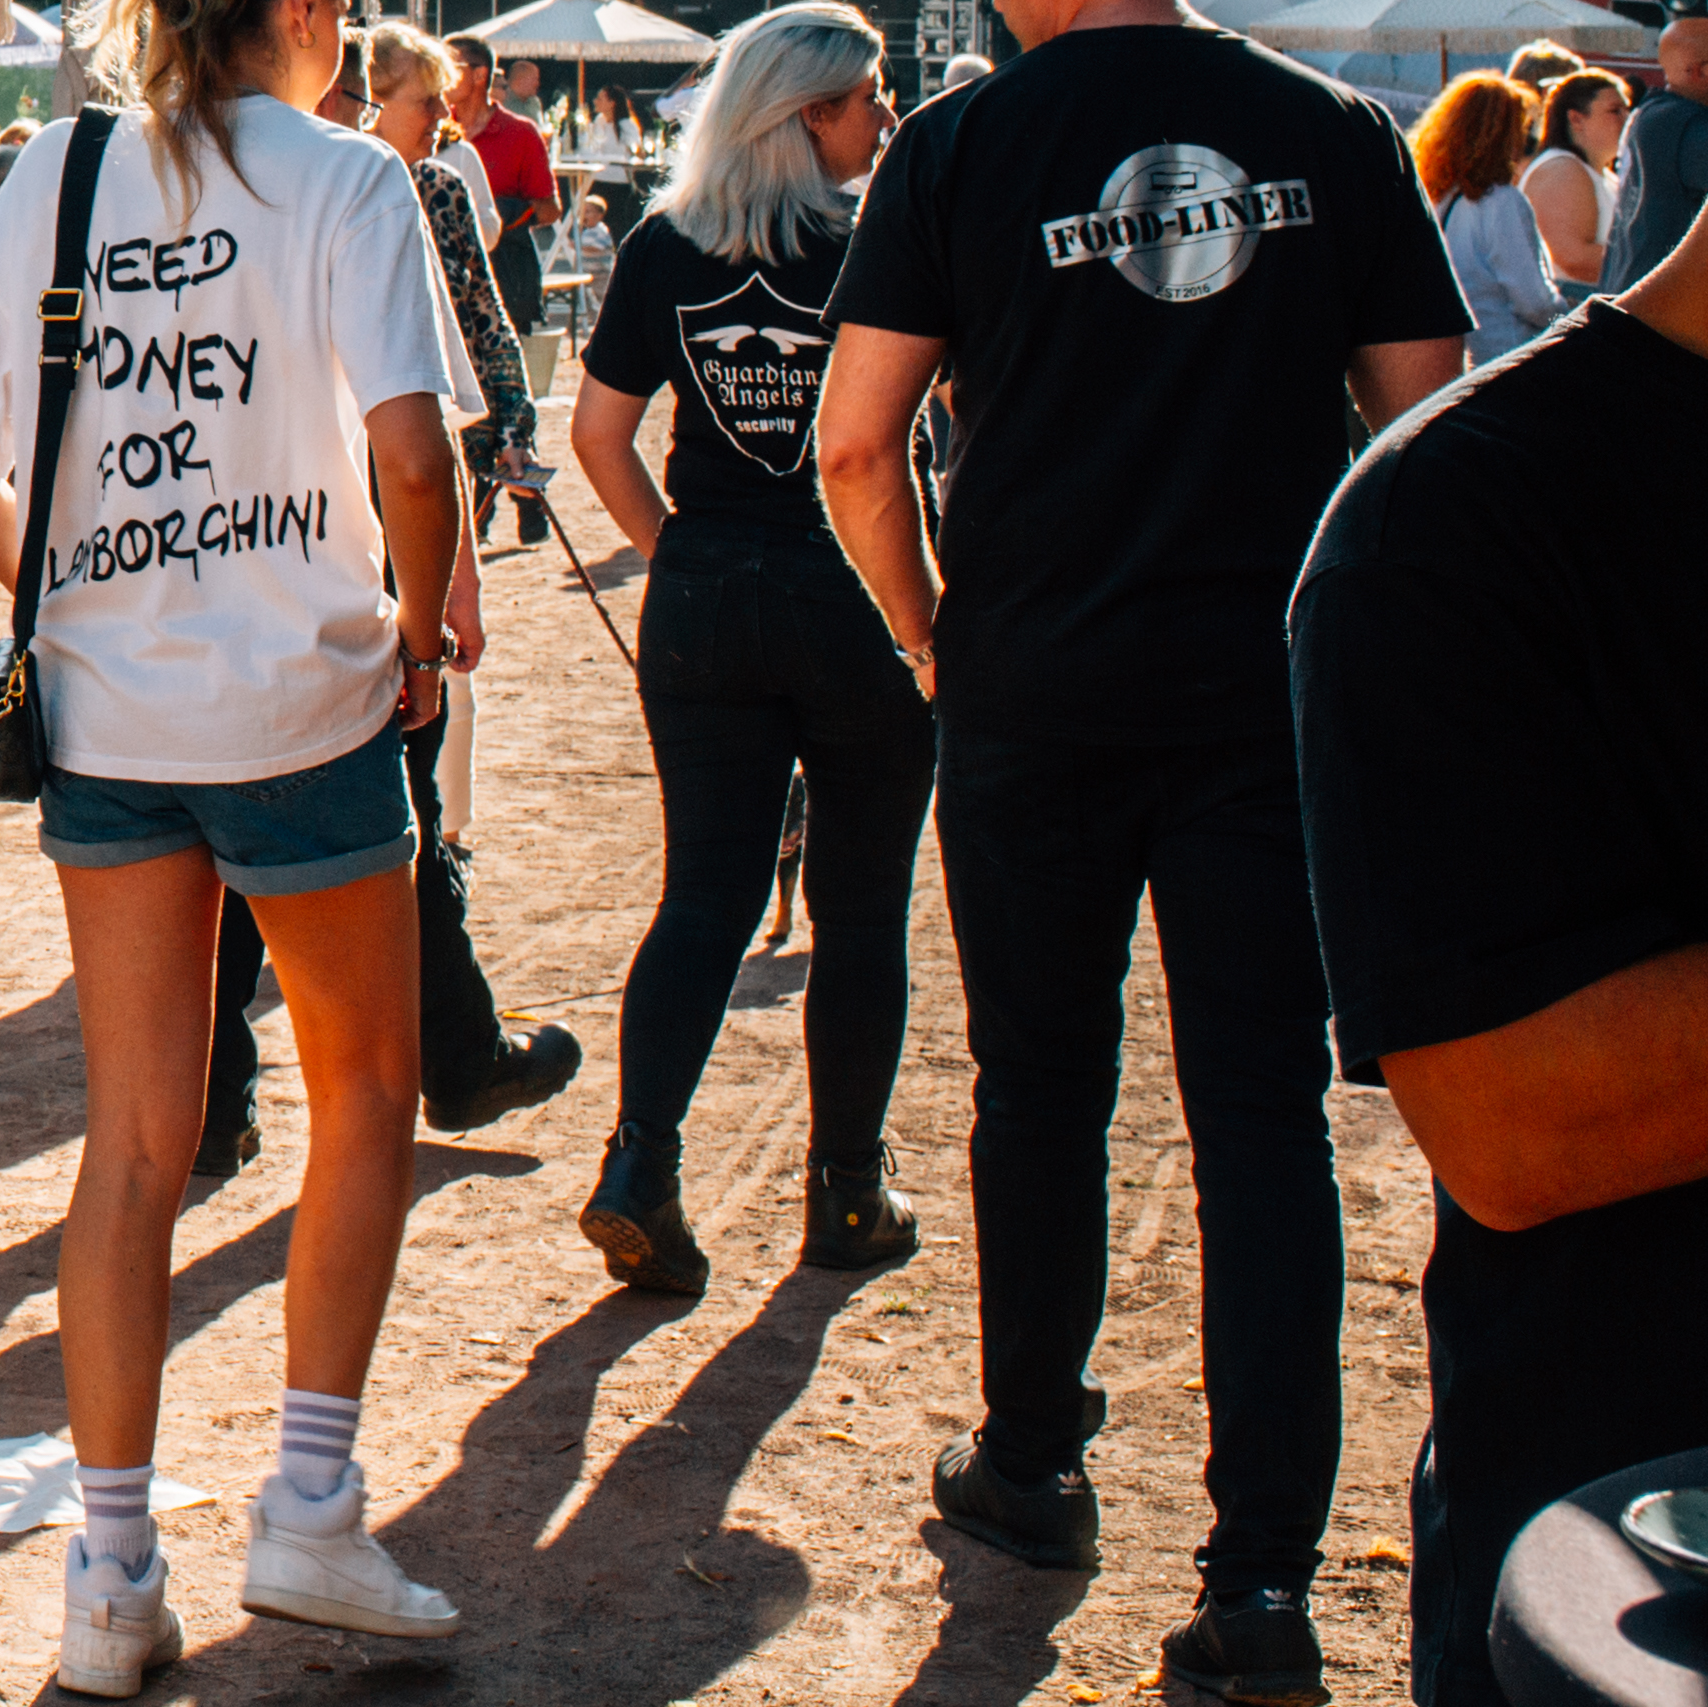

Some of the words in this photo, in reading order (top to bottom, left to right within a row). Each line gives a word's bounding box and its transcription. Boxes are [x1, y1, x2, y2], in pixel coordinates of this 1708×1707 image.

[1050, 187, 1309, 259] FOOD-LINER
[703, 359, 819, 386] Guardian
[718, 383, 805, 410] Angels
[735, 416, 796, 434] security
[97, 420, 216, 501] FOR
